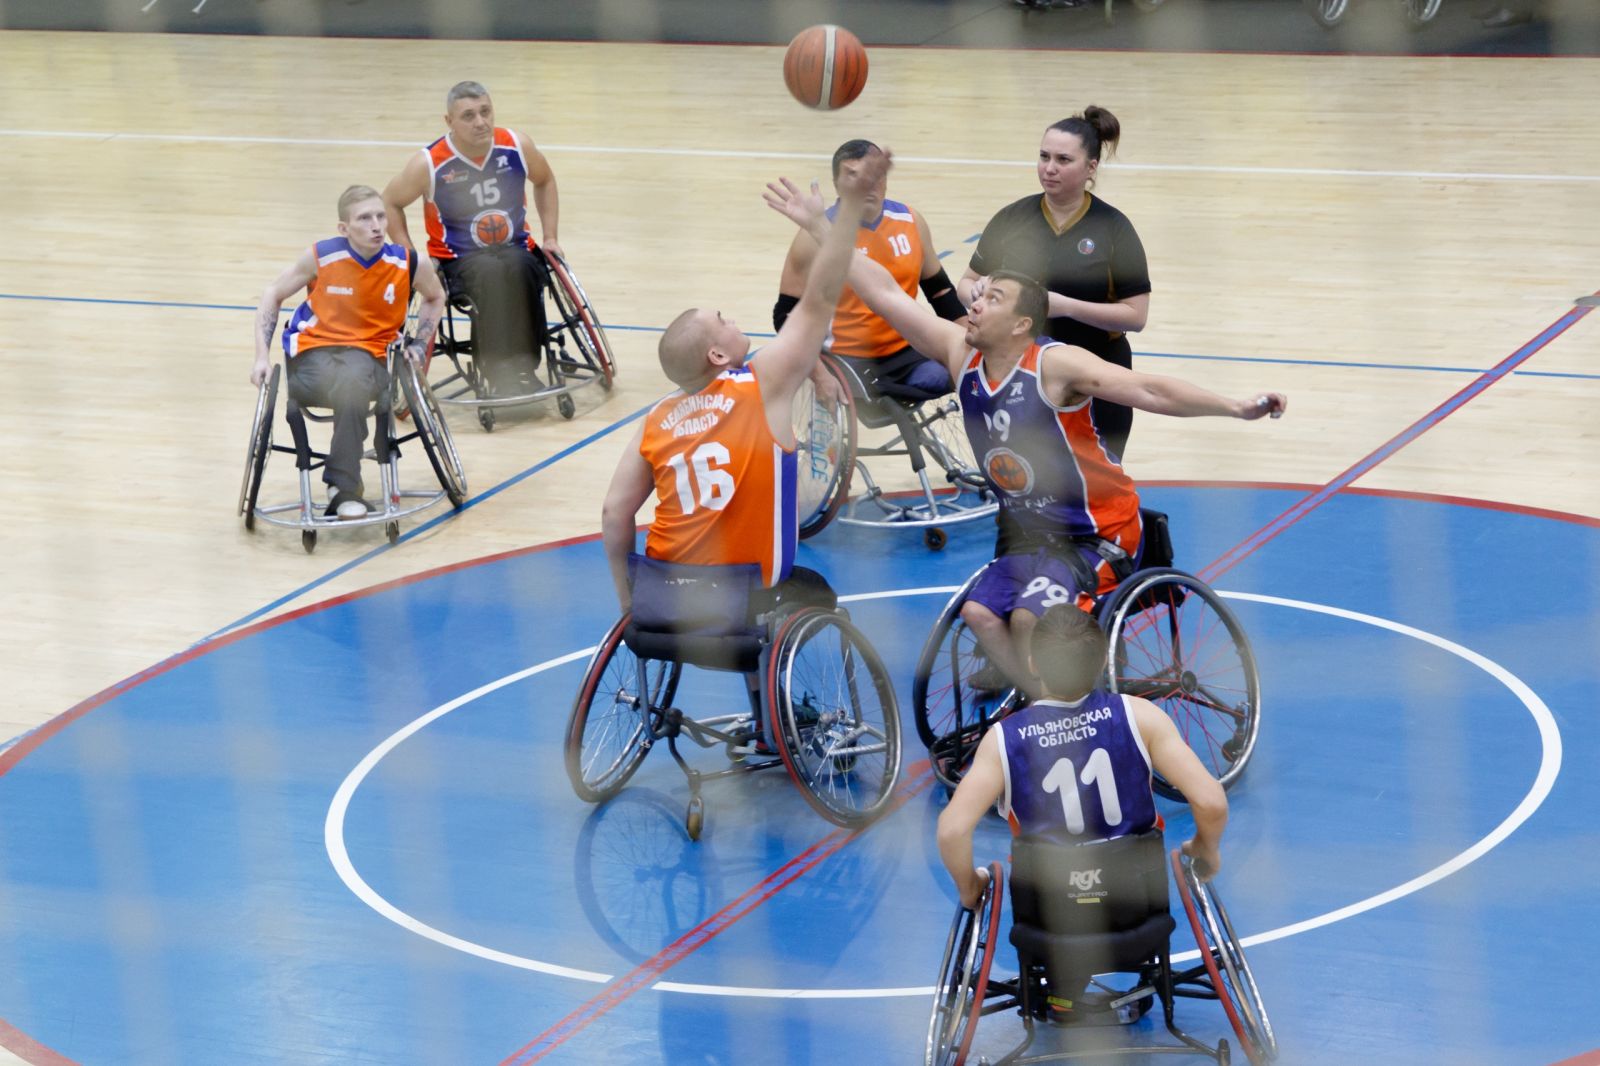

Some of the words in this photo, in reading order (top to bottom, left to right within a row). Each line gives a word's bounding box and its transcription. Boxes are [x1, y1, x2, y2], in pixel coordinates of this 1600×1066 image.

[470, 177, 501, 207] 15
[888, 233, 912, 257] 10
[384, 283, 396, 304] 4
[666, 441, 736, 515] 16
[1021, 576, 1070, 608] 99
[1017, 707, 1113, 740] УЛЬЯНОВСКАЯ
[1038, 725, 1098, 748] ОБЛАСТЬ
[1042, 747, 1123, 836] 11
